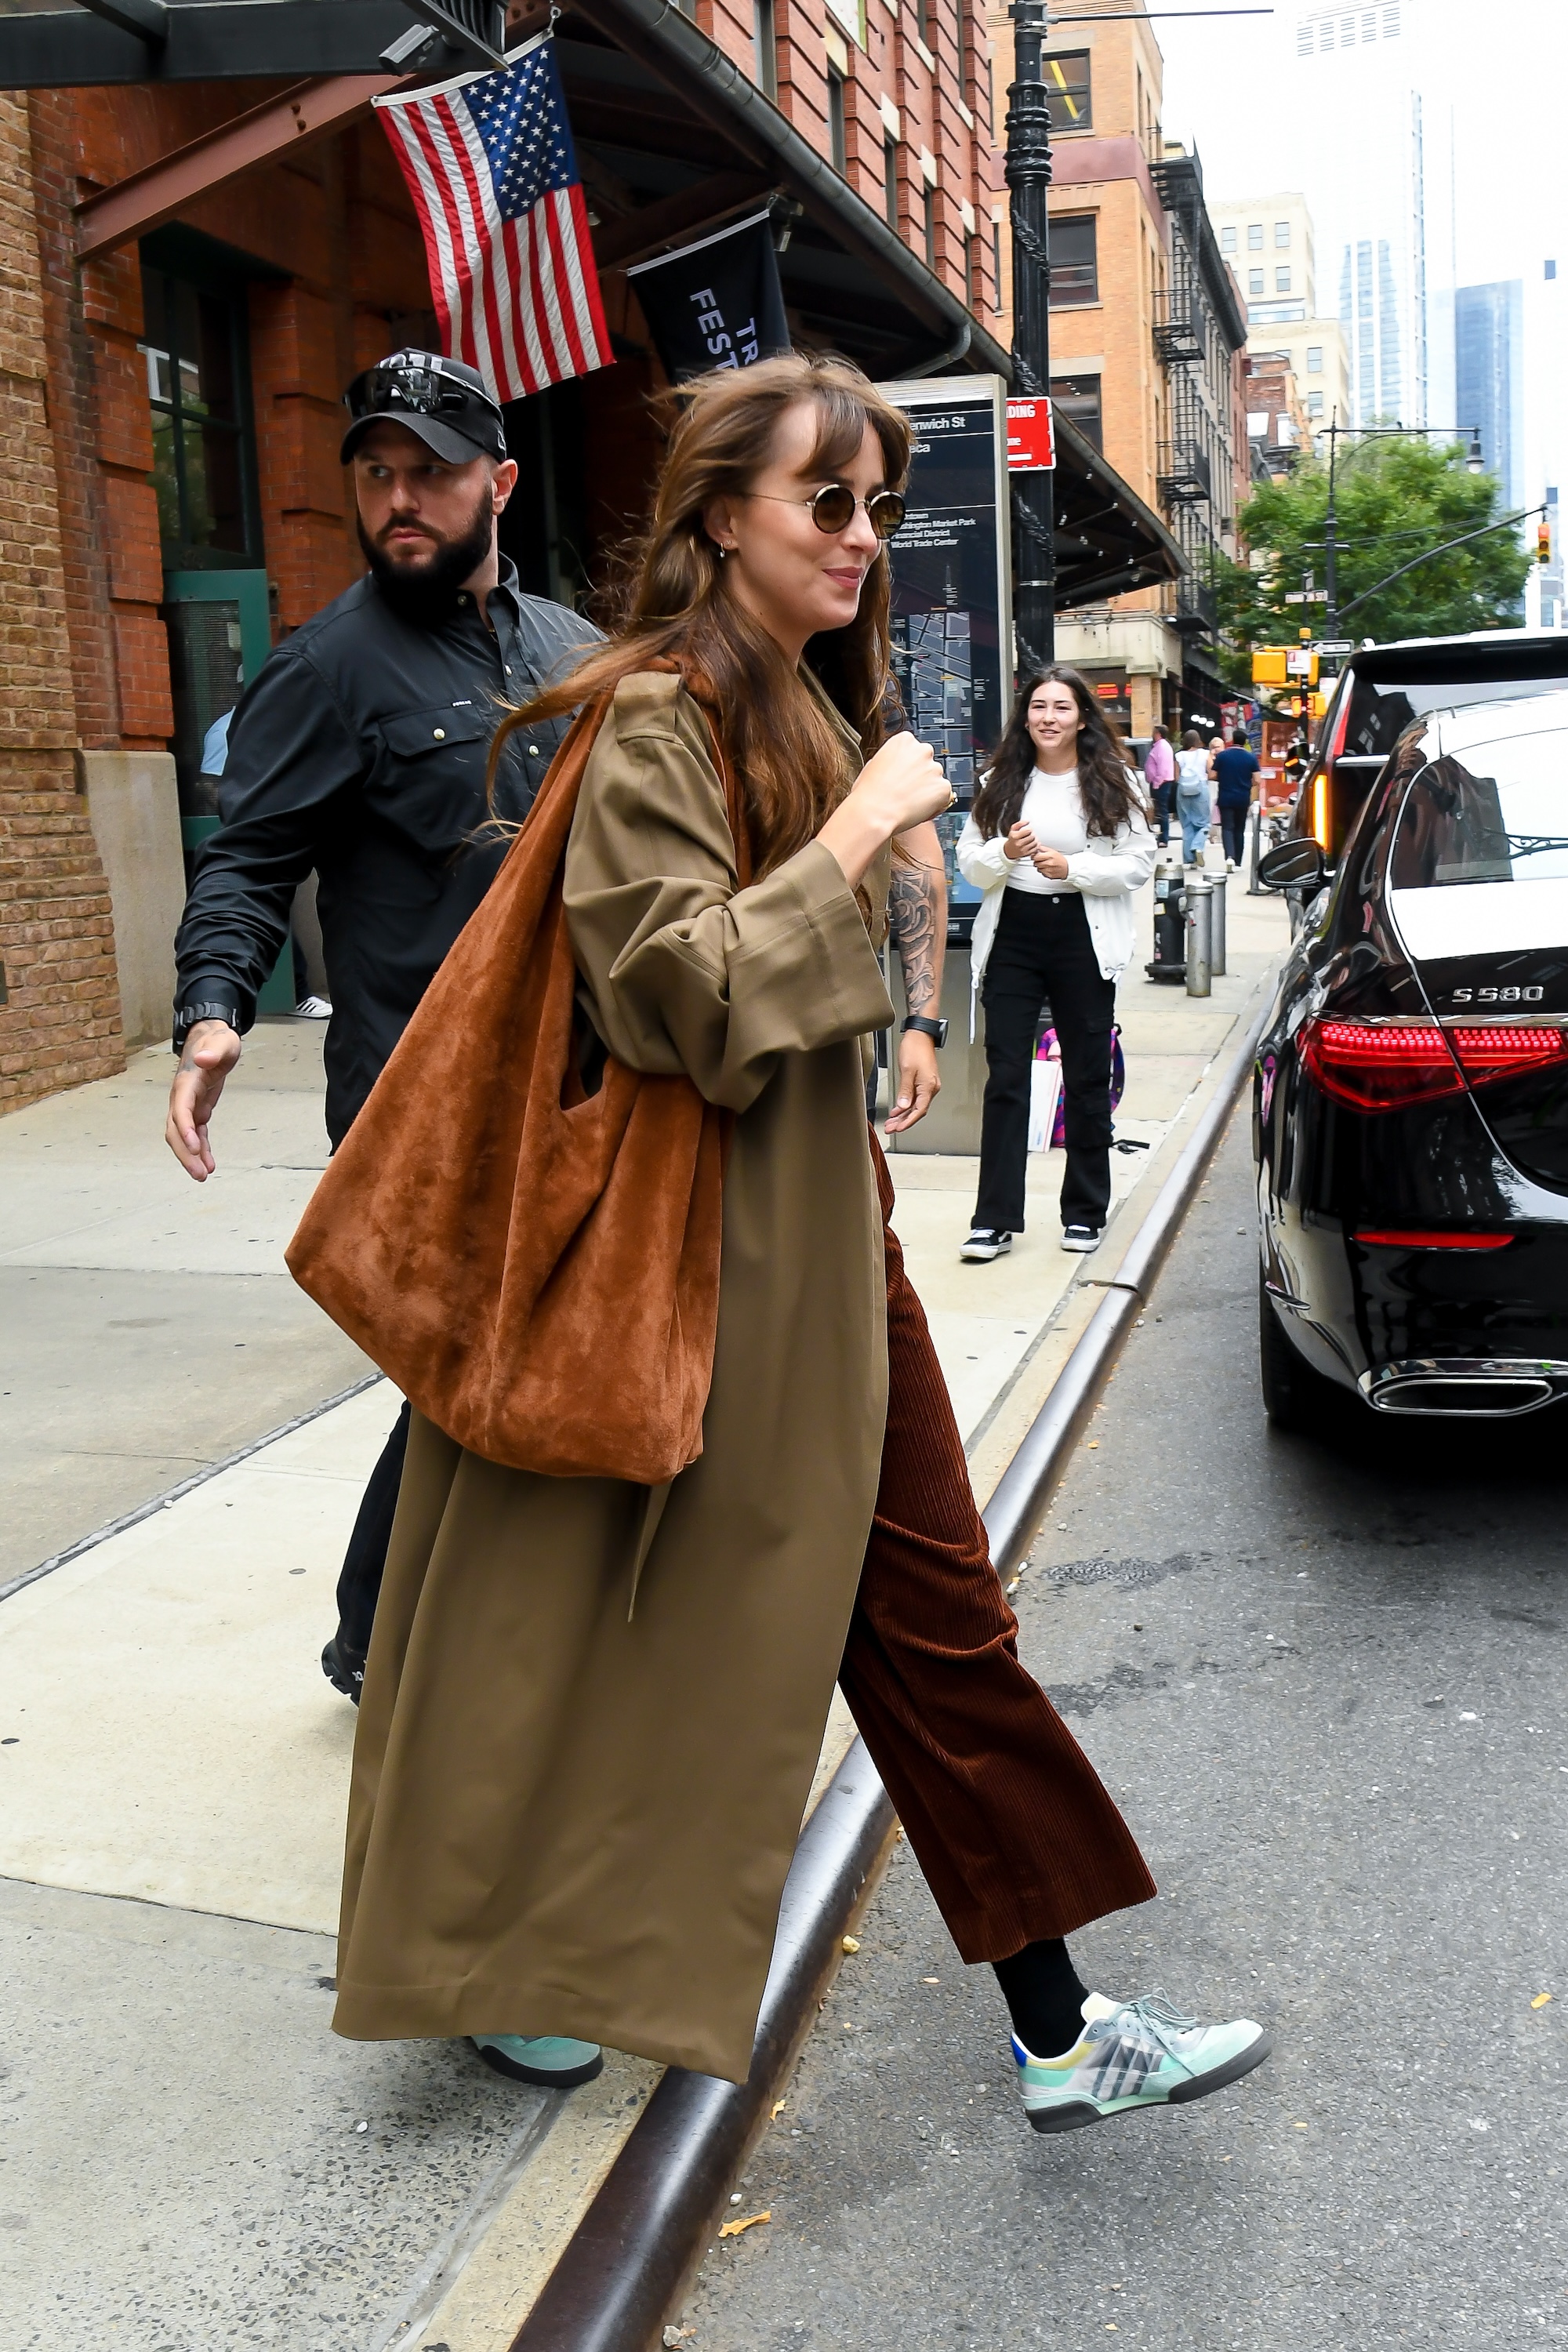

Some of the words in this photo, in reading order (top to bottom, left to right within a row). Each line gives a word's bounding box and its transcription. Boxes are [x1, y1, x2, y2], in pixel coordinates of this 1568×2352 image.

[689, 288, 739, 371] FEST
[735, 318, 759, 365] TR
[1005, 404, 1036, 419] DING
[909, 417, 950, 431] enwich
[951, 416, 966, 428] St
[909, 443, 931, 453] eca
[959, 517, 976, 526] Park
[1451, 988, 1473, 1003] S
[1476, 985, 1544, 1002] 580
